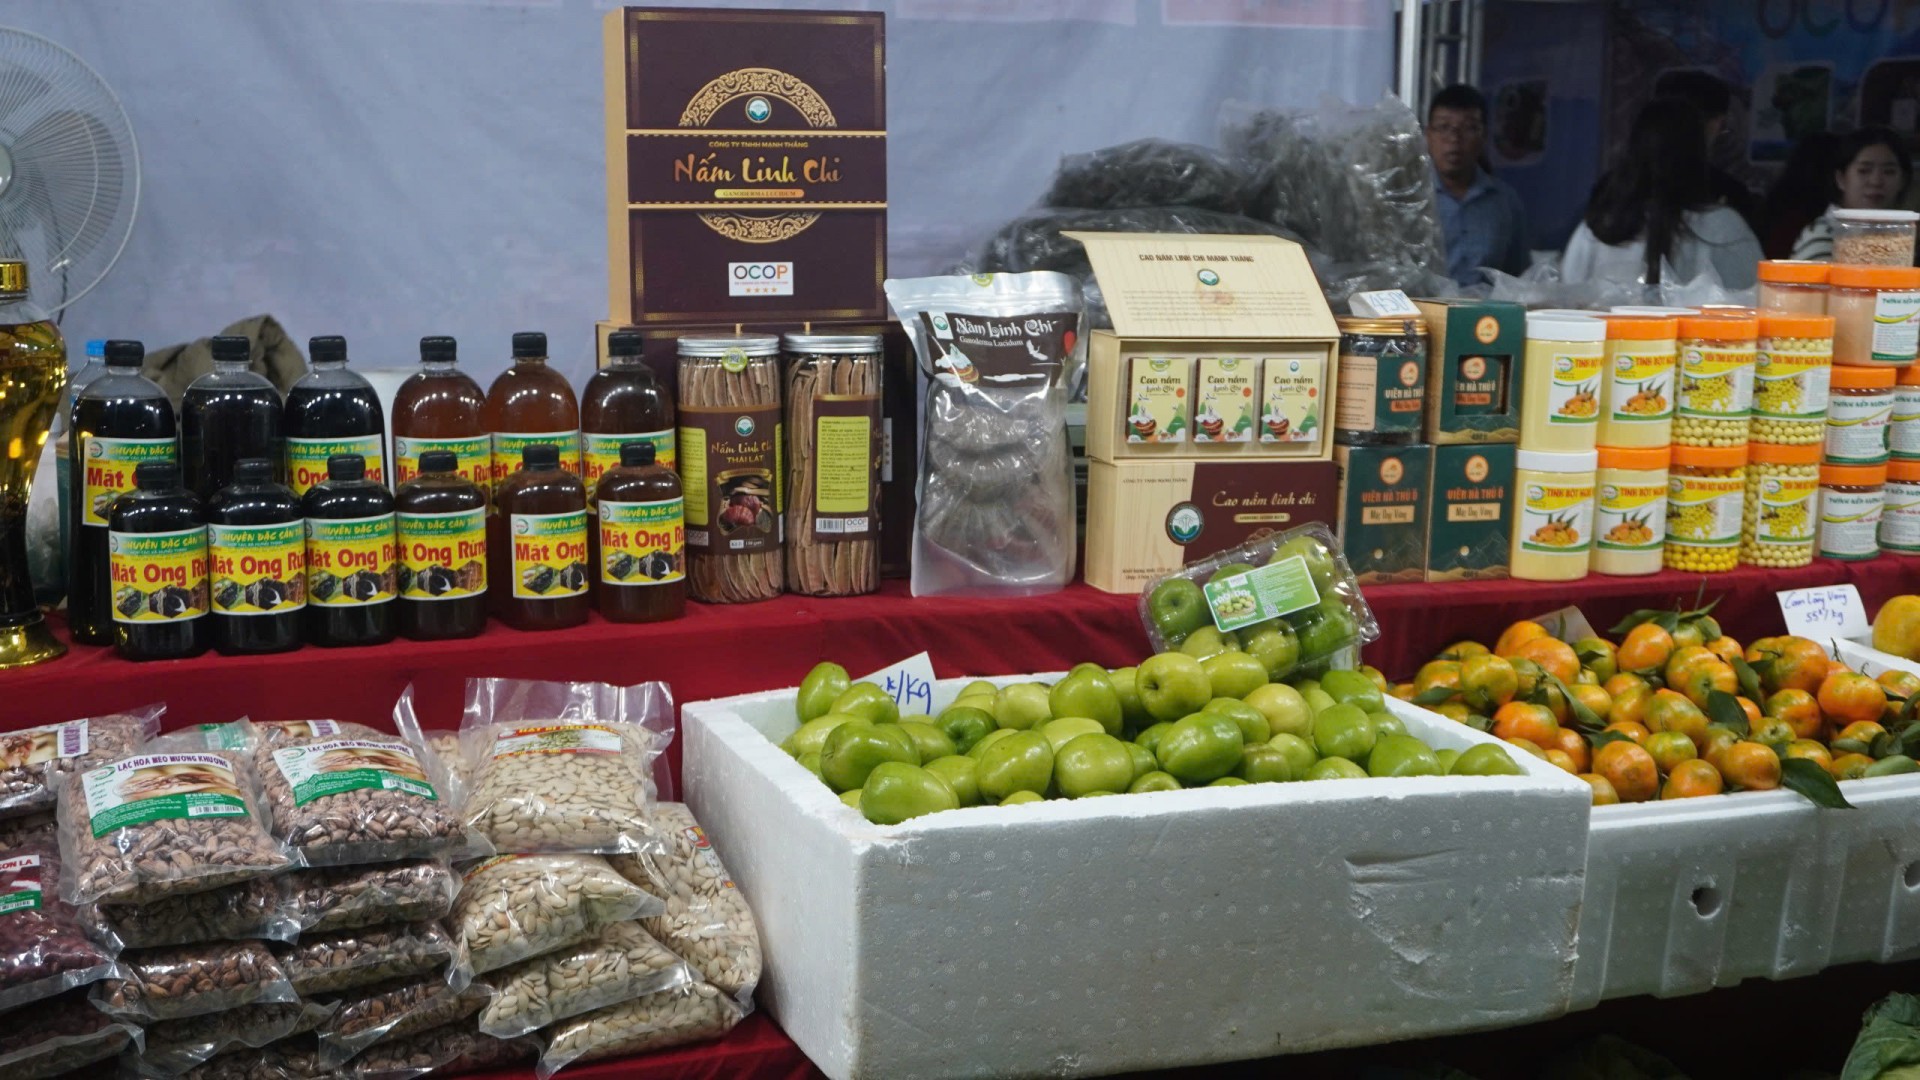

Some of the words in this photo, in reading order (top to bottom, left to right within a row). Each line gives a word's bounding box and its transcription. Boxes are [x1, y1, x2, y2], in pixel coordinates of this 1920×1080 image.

[674, 152, 736, 182] Nấm
[742, 156, 798, 183] Linh
[803, 156, 843, 184] Chi
[734, 264, 788, 280] OCOP
[1140, 376, 1158, 384] Cao
[1207, 376, 1225, 384] Cao
[1274, 376, 1292, 384] Cao
[88, 467, 124, 491] Mật
[1212, 491, 1238, 507] Cao
[1272, 492, 1296, 506] linh
[1298, 492, 1317, 505] chi
[602, 528, 628, 552] Mật
[635, 530, 671, 552] Ong
[338, 548, 378, 572] Ong
[413, 543, 452, 568] Ong
[516, 542, 550, 566] Mật
[556, 542, 585, 562] Ong
[144, 564, 187, 588] Ong
[240, 556, 282, 580] Ong
[134, 758, 150, 768] HOA
